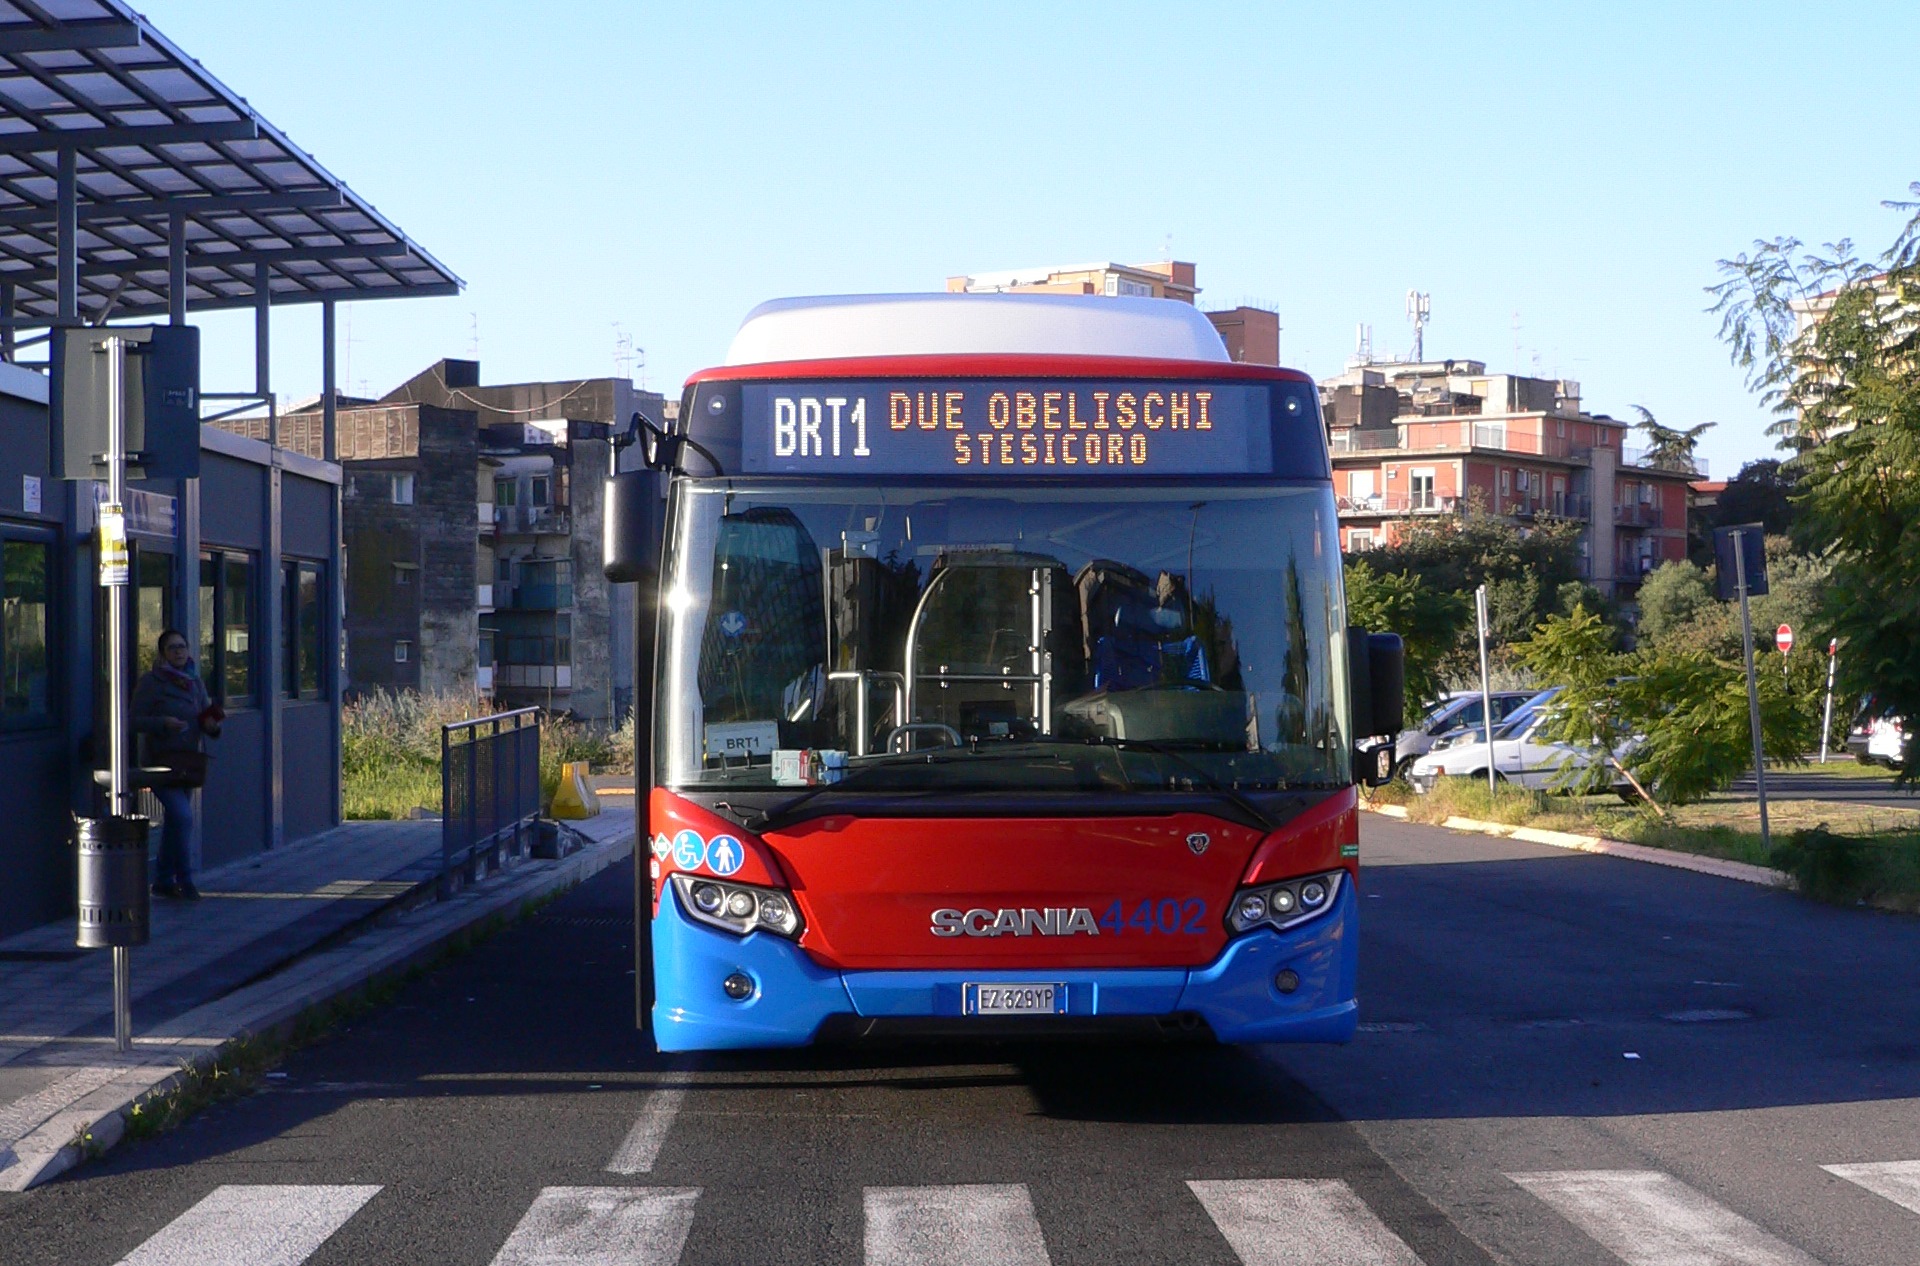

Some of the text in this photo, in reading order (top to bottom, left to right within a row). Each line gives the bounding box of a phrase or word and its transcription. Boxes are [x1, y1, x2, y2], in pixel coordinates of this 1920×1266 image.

[775, 397, 870, 457] BRT1
[890, 391, 1213, 430] DUE OBELISCHI
[954, 433, 1147, 465] STESICORO
[726, 736, 759, 750] BRT1
[930, 907, 1100, 937] SCANIA
[1099, 898, 1207, 935] 4402
